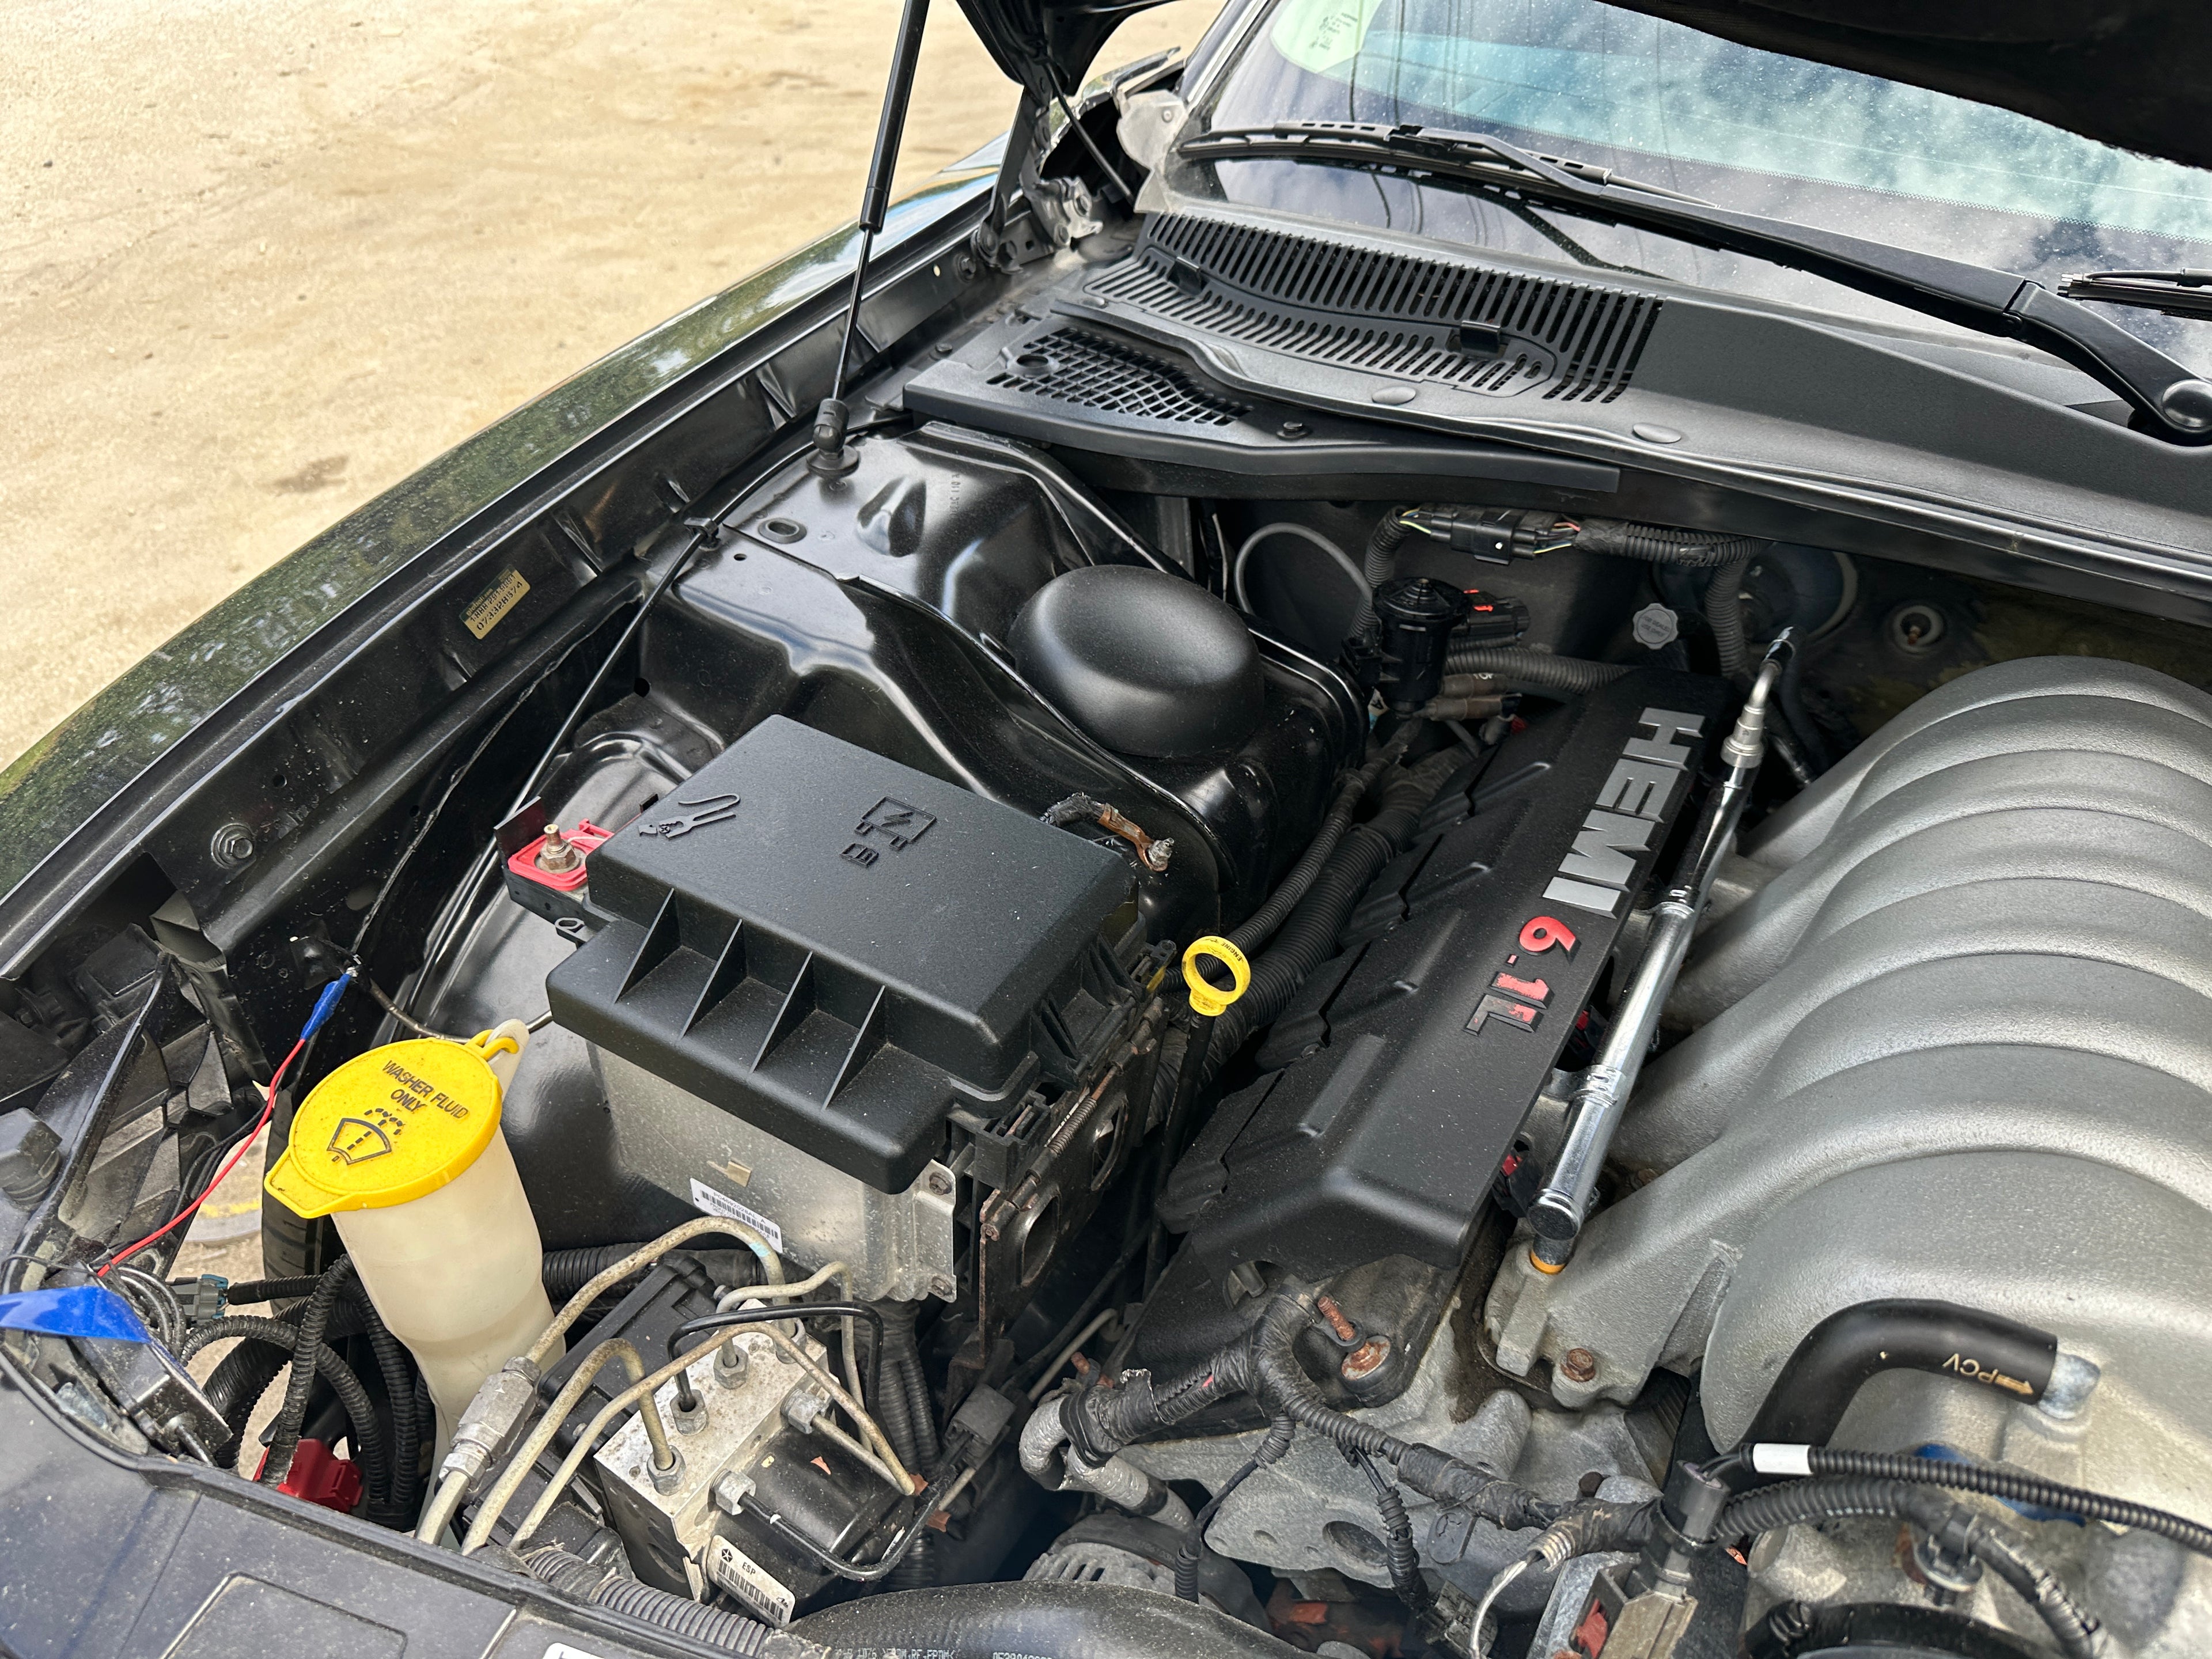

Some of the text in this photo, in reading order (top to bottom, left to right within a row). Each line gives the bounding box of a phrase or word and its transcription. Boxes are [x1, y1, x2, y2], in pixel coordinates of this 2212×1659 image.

[1542, 707, 1705, 918] HEMI
[1221, 941, 1243, 962] ENGINE
[1463, 916, 1581, 1036] 6.1L
[382, 1060, 468, 1119] WASHER FLUID
[391, 1089, 427, 1112] ONLY
[1942, 1353, 1998, 1384] PCV
[742, 1562, 756, 1575] ESP
